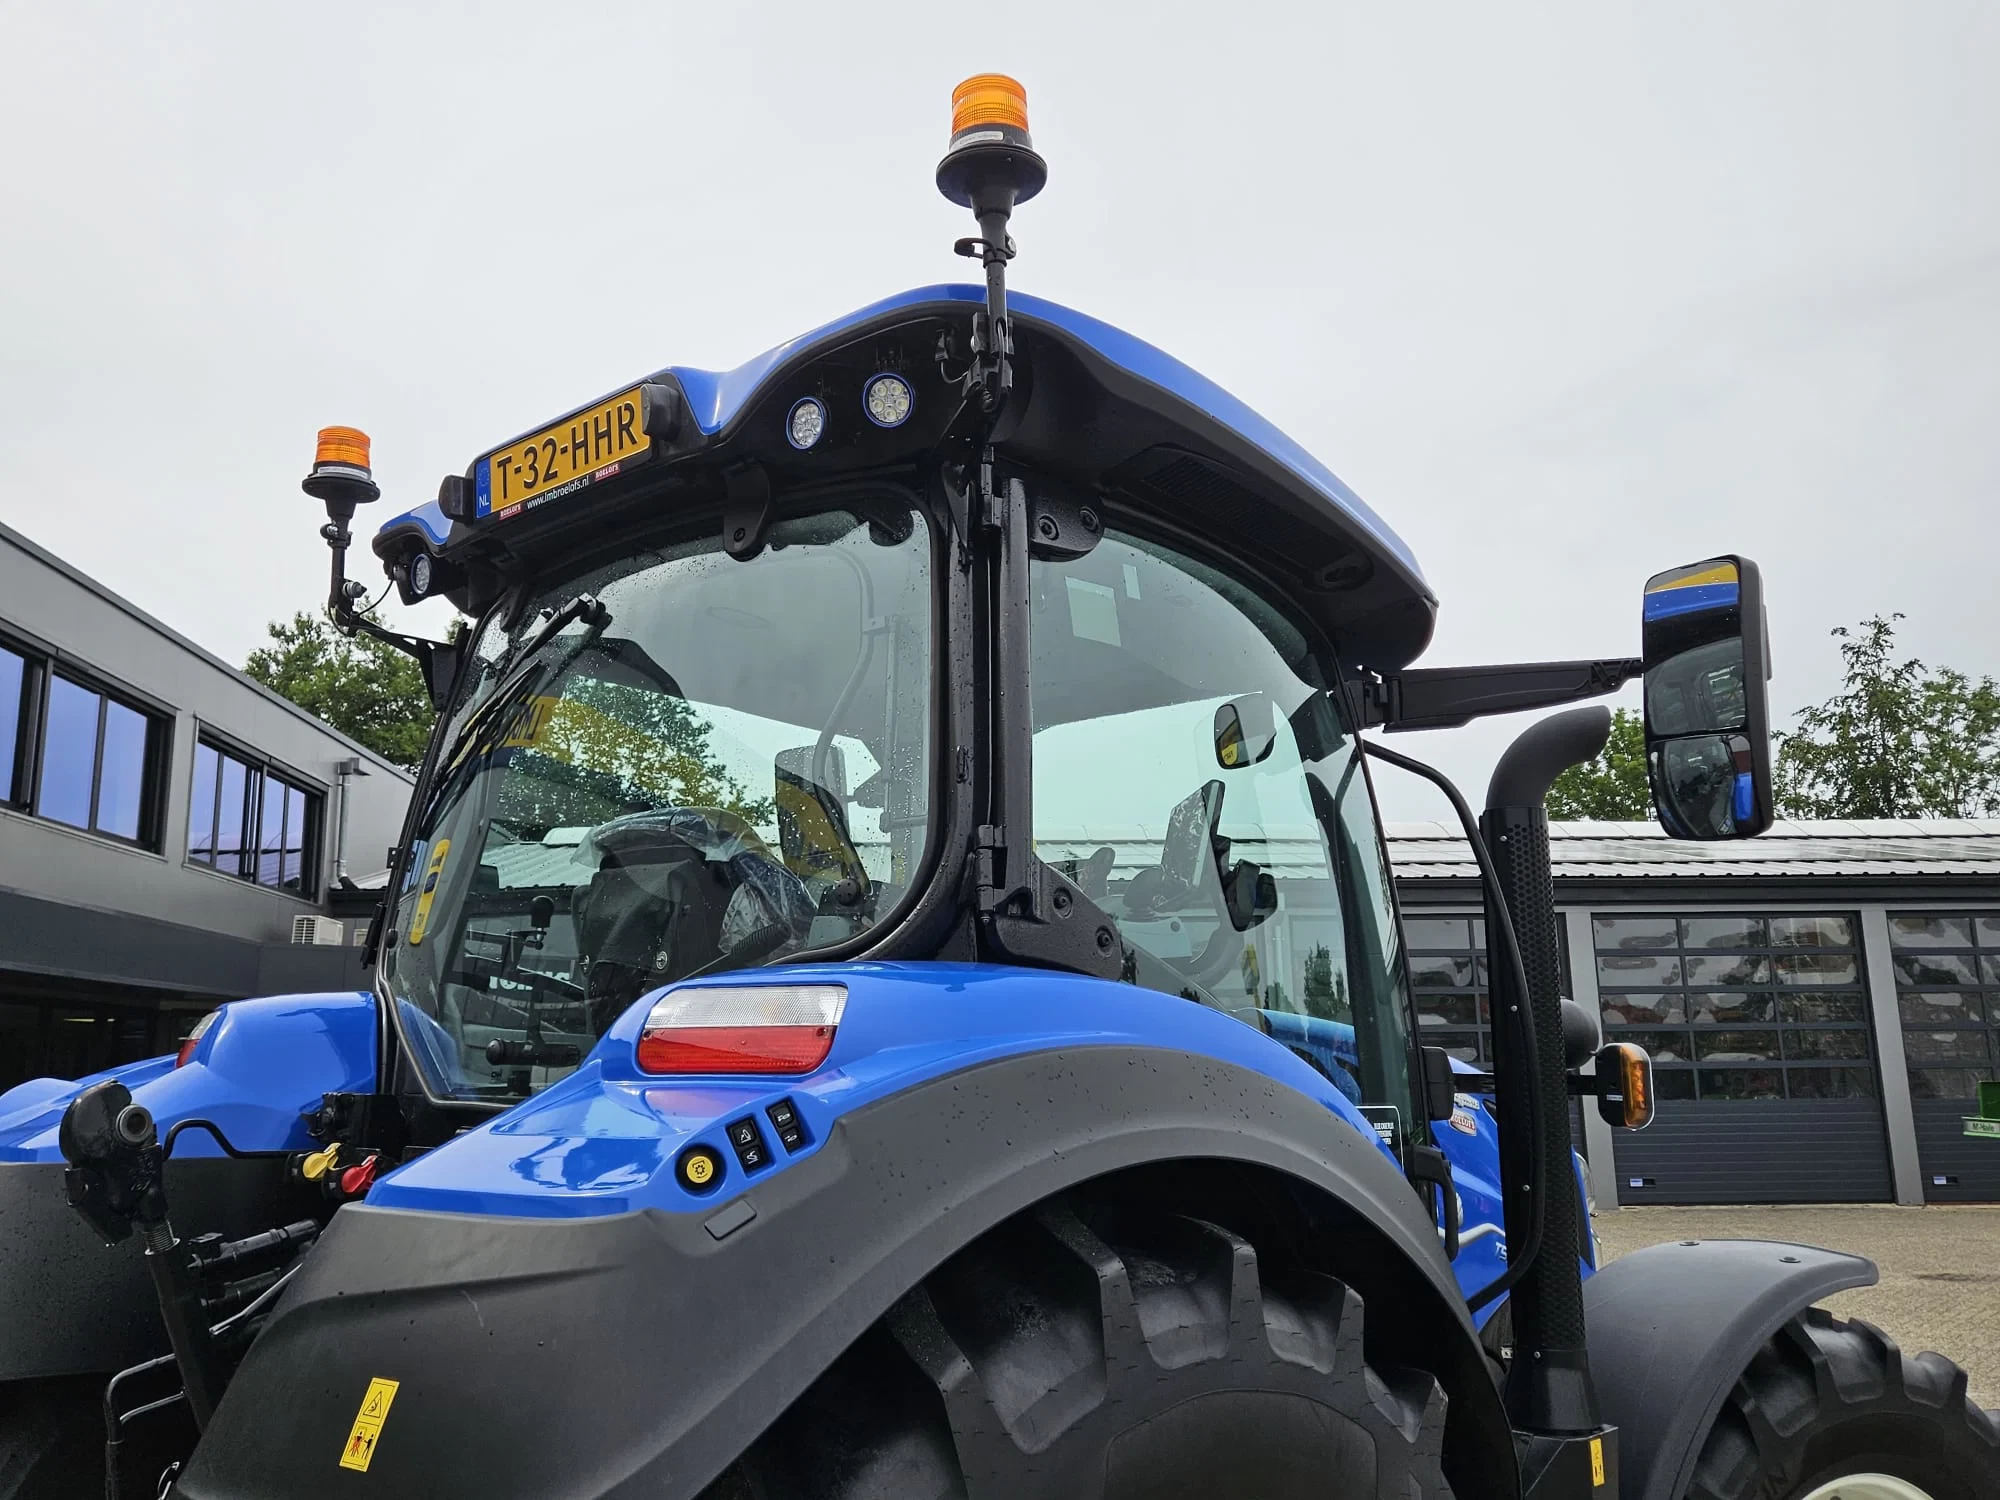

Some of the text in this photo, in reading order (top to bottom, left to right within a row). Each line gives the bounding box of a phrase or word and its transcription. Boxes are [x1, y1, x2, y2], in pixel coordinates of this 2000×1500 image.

[497, 401, 637, 499] T-32-HHR
[479, 494, 490, 509] NL
[527, 475, 589, 509] www.lmbroelofs.nl
